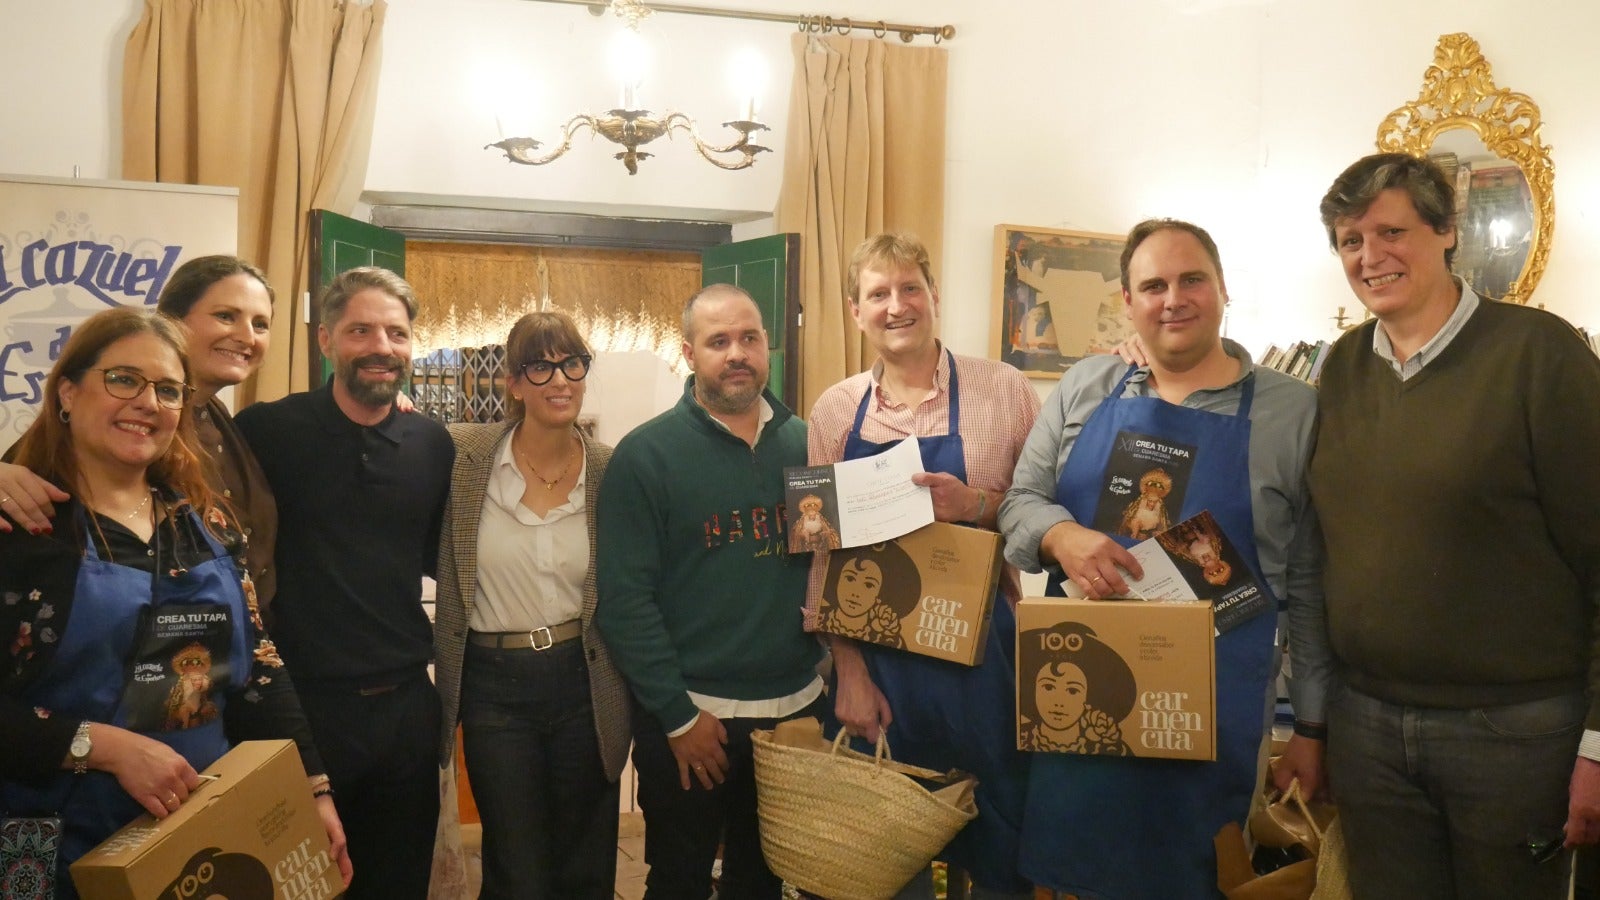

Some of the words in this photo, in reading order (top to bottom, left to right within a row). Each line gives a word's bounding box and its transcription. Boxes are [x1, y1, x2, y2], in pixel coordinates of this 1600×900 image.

[0, 341, 49, 404] Es
[1135, 439, 1155, 449] CREA
[1157, 444, 1167, 452] TU
[1168, 447, 1189, 458] TAPA
[1229, 596, 1240, 605] TU
[1238, 586, 1258, 599] CREA
[921, 595, 963, 617] car
[157, 615, 186, 624] CREA
[187, 614, 202, 622] TU
[203, 613, 227, 622] TAPA
[918, 611, 970, 637] men
[914, 628, 959, 653] cita
[1039, 632, 1083, 651] 100
[1139, 690, 1188, 711] car
[1139, 709, 1204, 731] men
[1140, 728, 1194, 751] cita
[275, 838, 312, 883] car
[172, 861, 214, 900] 100
[280, 850, 331, 900] men
